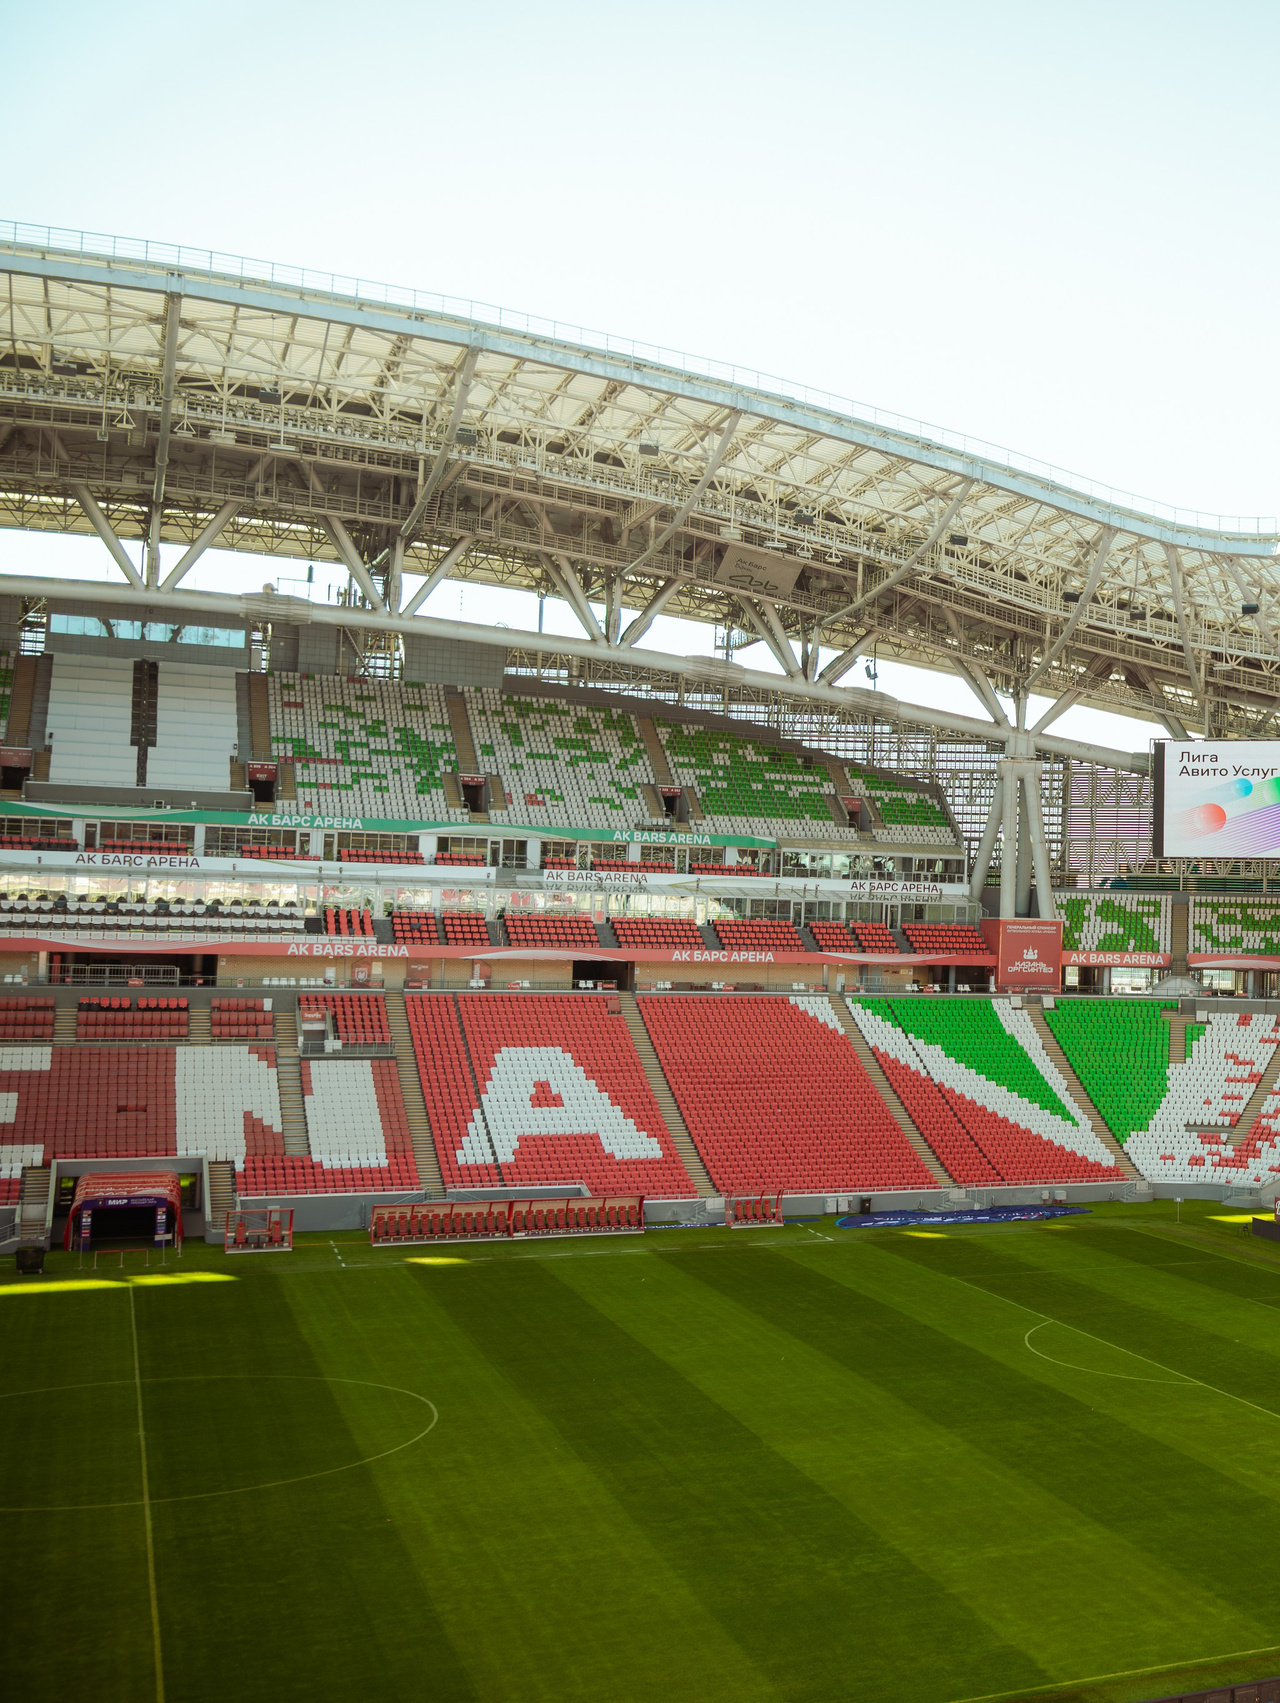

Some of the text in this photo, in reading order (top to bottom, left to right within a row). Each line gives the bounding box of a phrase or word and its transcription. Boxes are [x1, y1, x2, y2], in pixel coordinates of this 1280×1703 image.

[1179, 751, 1218, 763] Лига
[1179, 765, 1278, 779] Авито Услуг
[248, 814, 363, 829] АК БАРС АРЕНА
[613, 831, 711, 845] AK BARS ARENA
[75, 853, 201, 868] АК БАРС АРЕНА
[546, 871, 648, 883] AK BARS ARENA
[850, 881, 939, 893] АК БАРС АРЕНА
[287, 943, 409, 957] AK BARS ARENA
[672, 950, 774, 963] АК БАРС АРЕНА
[1070, 953, 1164, 965] AK BARS ARENA
